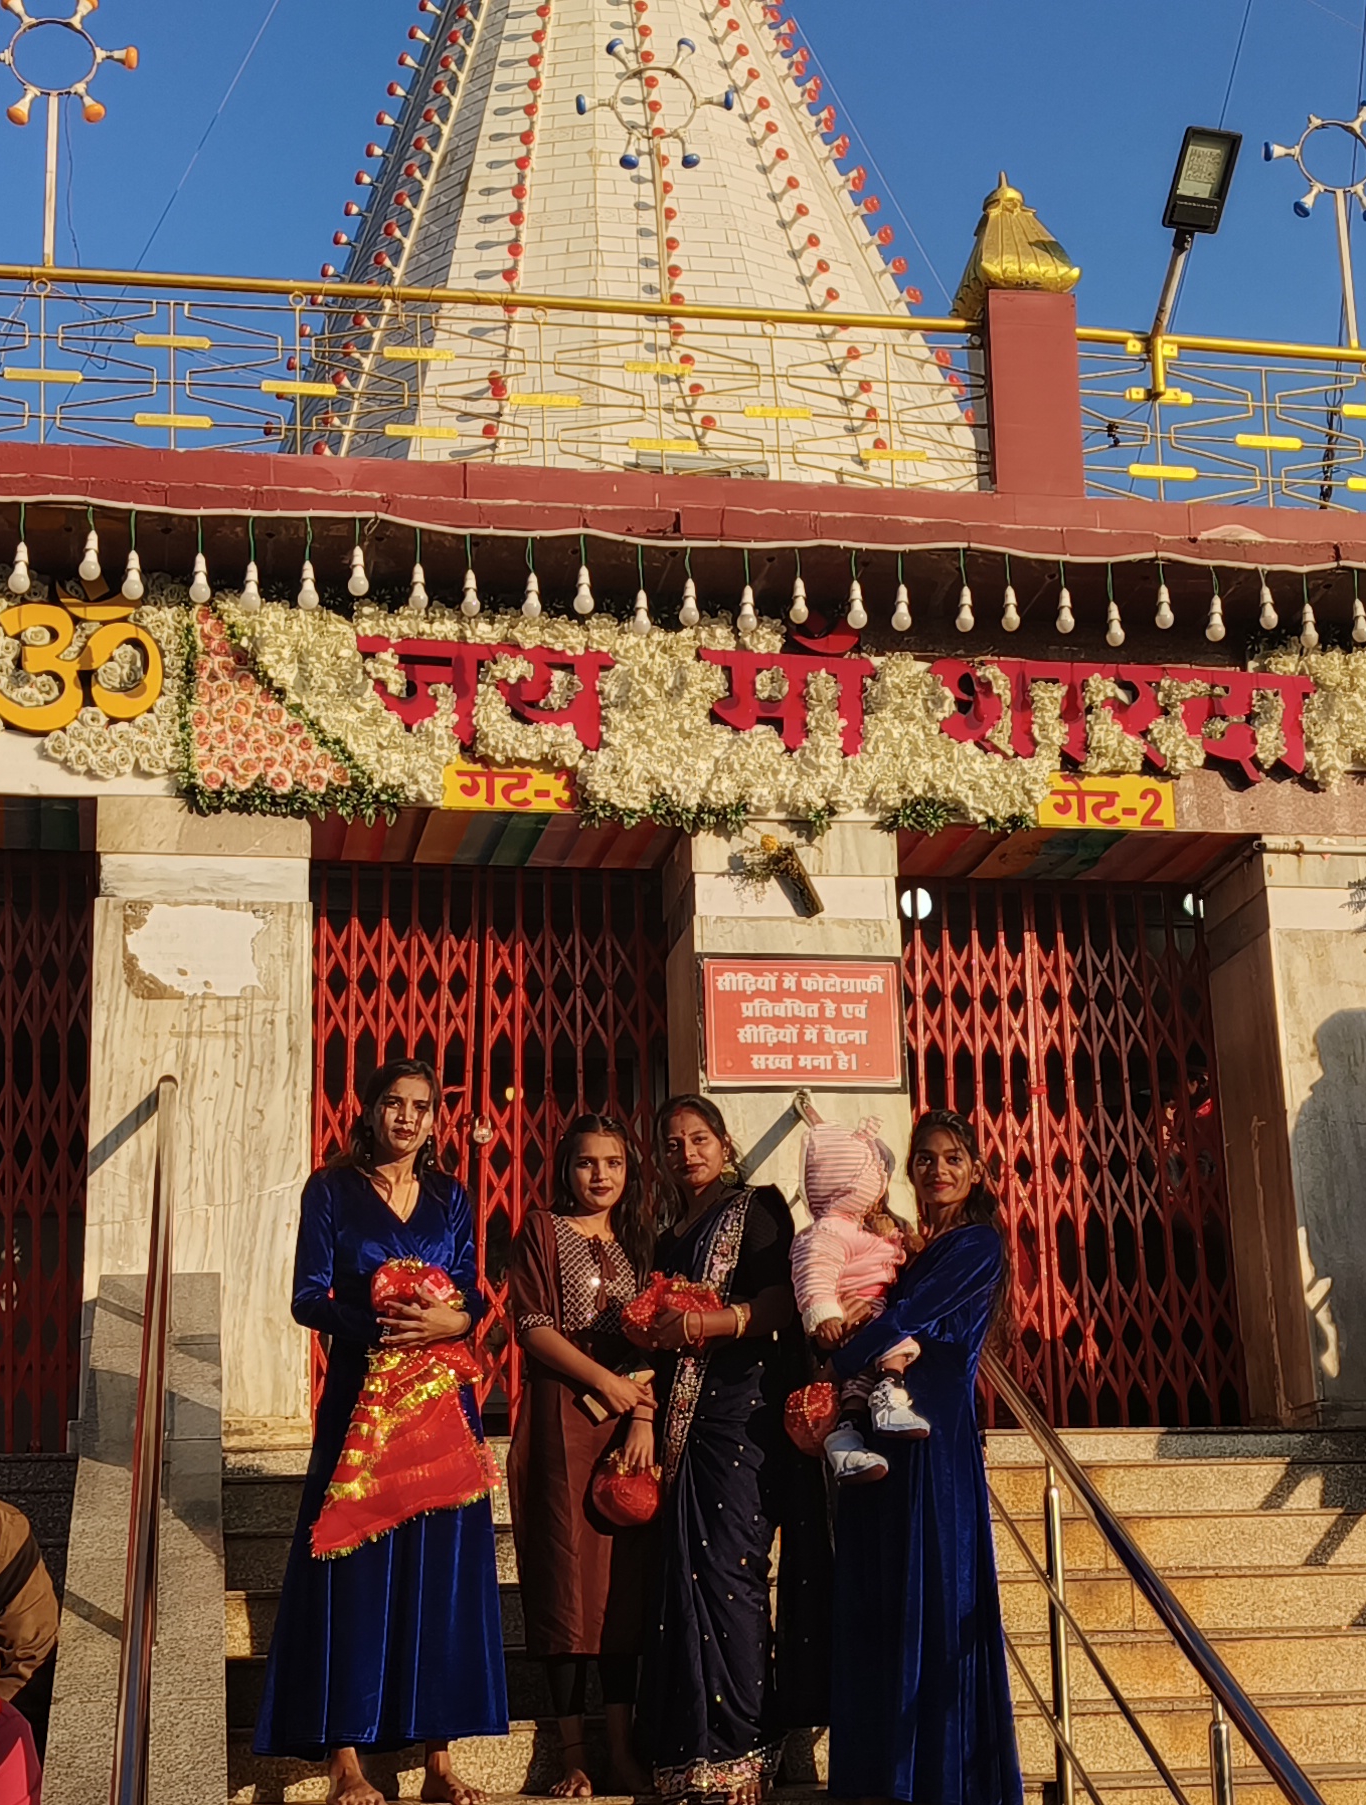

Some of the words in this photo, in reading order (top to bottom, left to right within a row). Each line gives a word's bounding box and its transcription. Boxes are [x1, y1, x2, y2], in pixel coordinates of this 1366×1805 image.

[357, 636, 616, 750] जय
[929, 657, 1315, 783] शारदा
[1050, 774, 1165, 827] गेट-2
[782, 972, 800, 993] में
[800, 972, 885, 995] फोटोग्राफी
[821, 998, 837, 1018] है
[841, 999, 869, 1019] एवं
[803, 1023, 820, 1044] में
[750, 1053, 794, 1070] सख्त
[797, 1054, 833, 1070] मना
